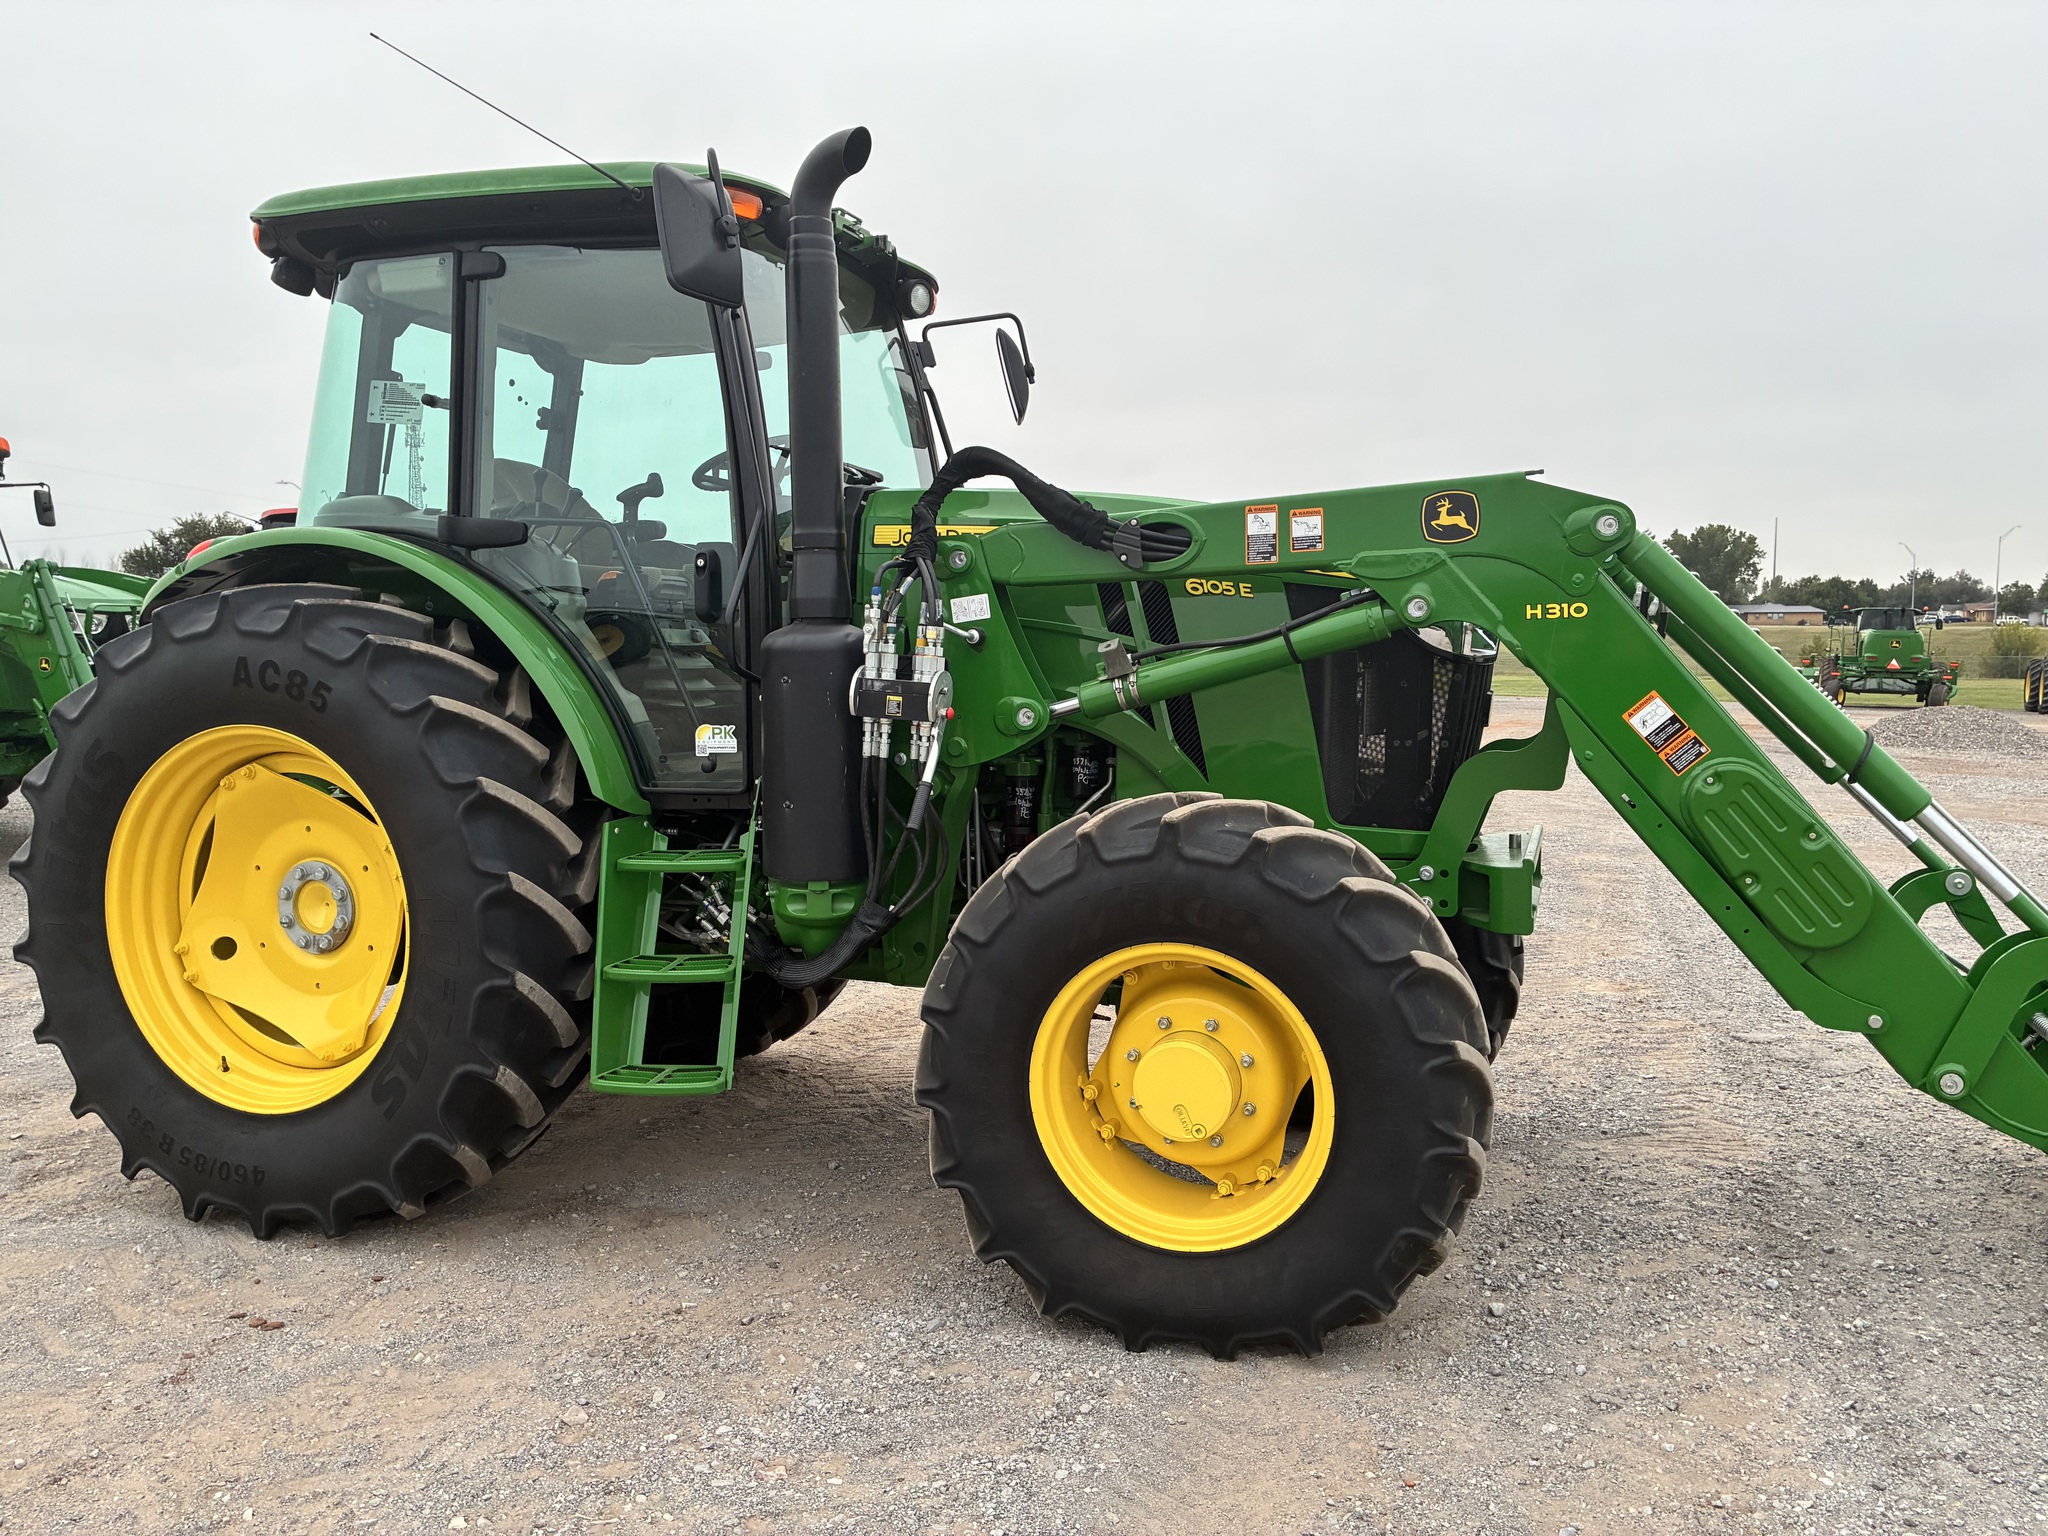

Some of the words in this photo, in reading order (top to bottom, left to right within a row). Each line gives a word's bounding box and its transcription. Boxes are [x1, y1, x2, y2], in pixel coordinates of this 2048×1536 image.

[1184, 578, 1236, 597] 6105
[1238, 582, 1255, 598] E
[232, 655, 334, 714] AC85
[1632, 695, 1654, 712] WARNING
[1670, 734, 1691, 752] WARNING
[126, 1107, 155, 1138] 38
[158, 1132, 175, 1157] R
[177, 1145, 266, 1186] 460/85
